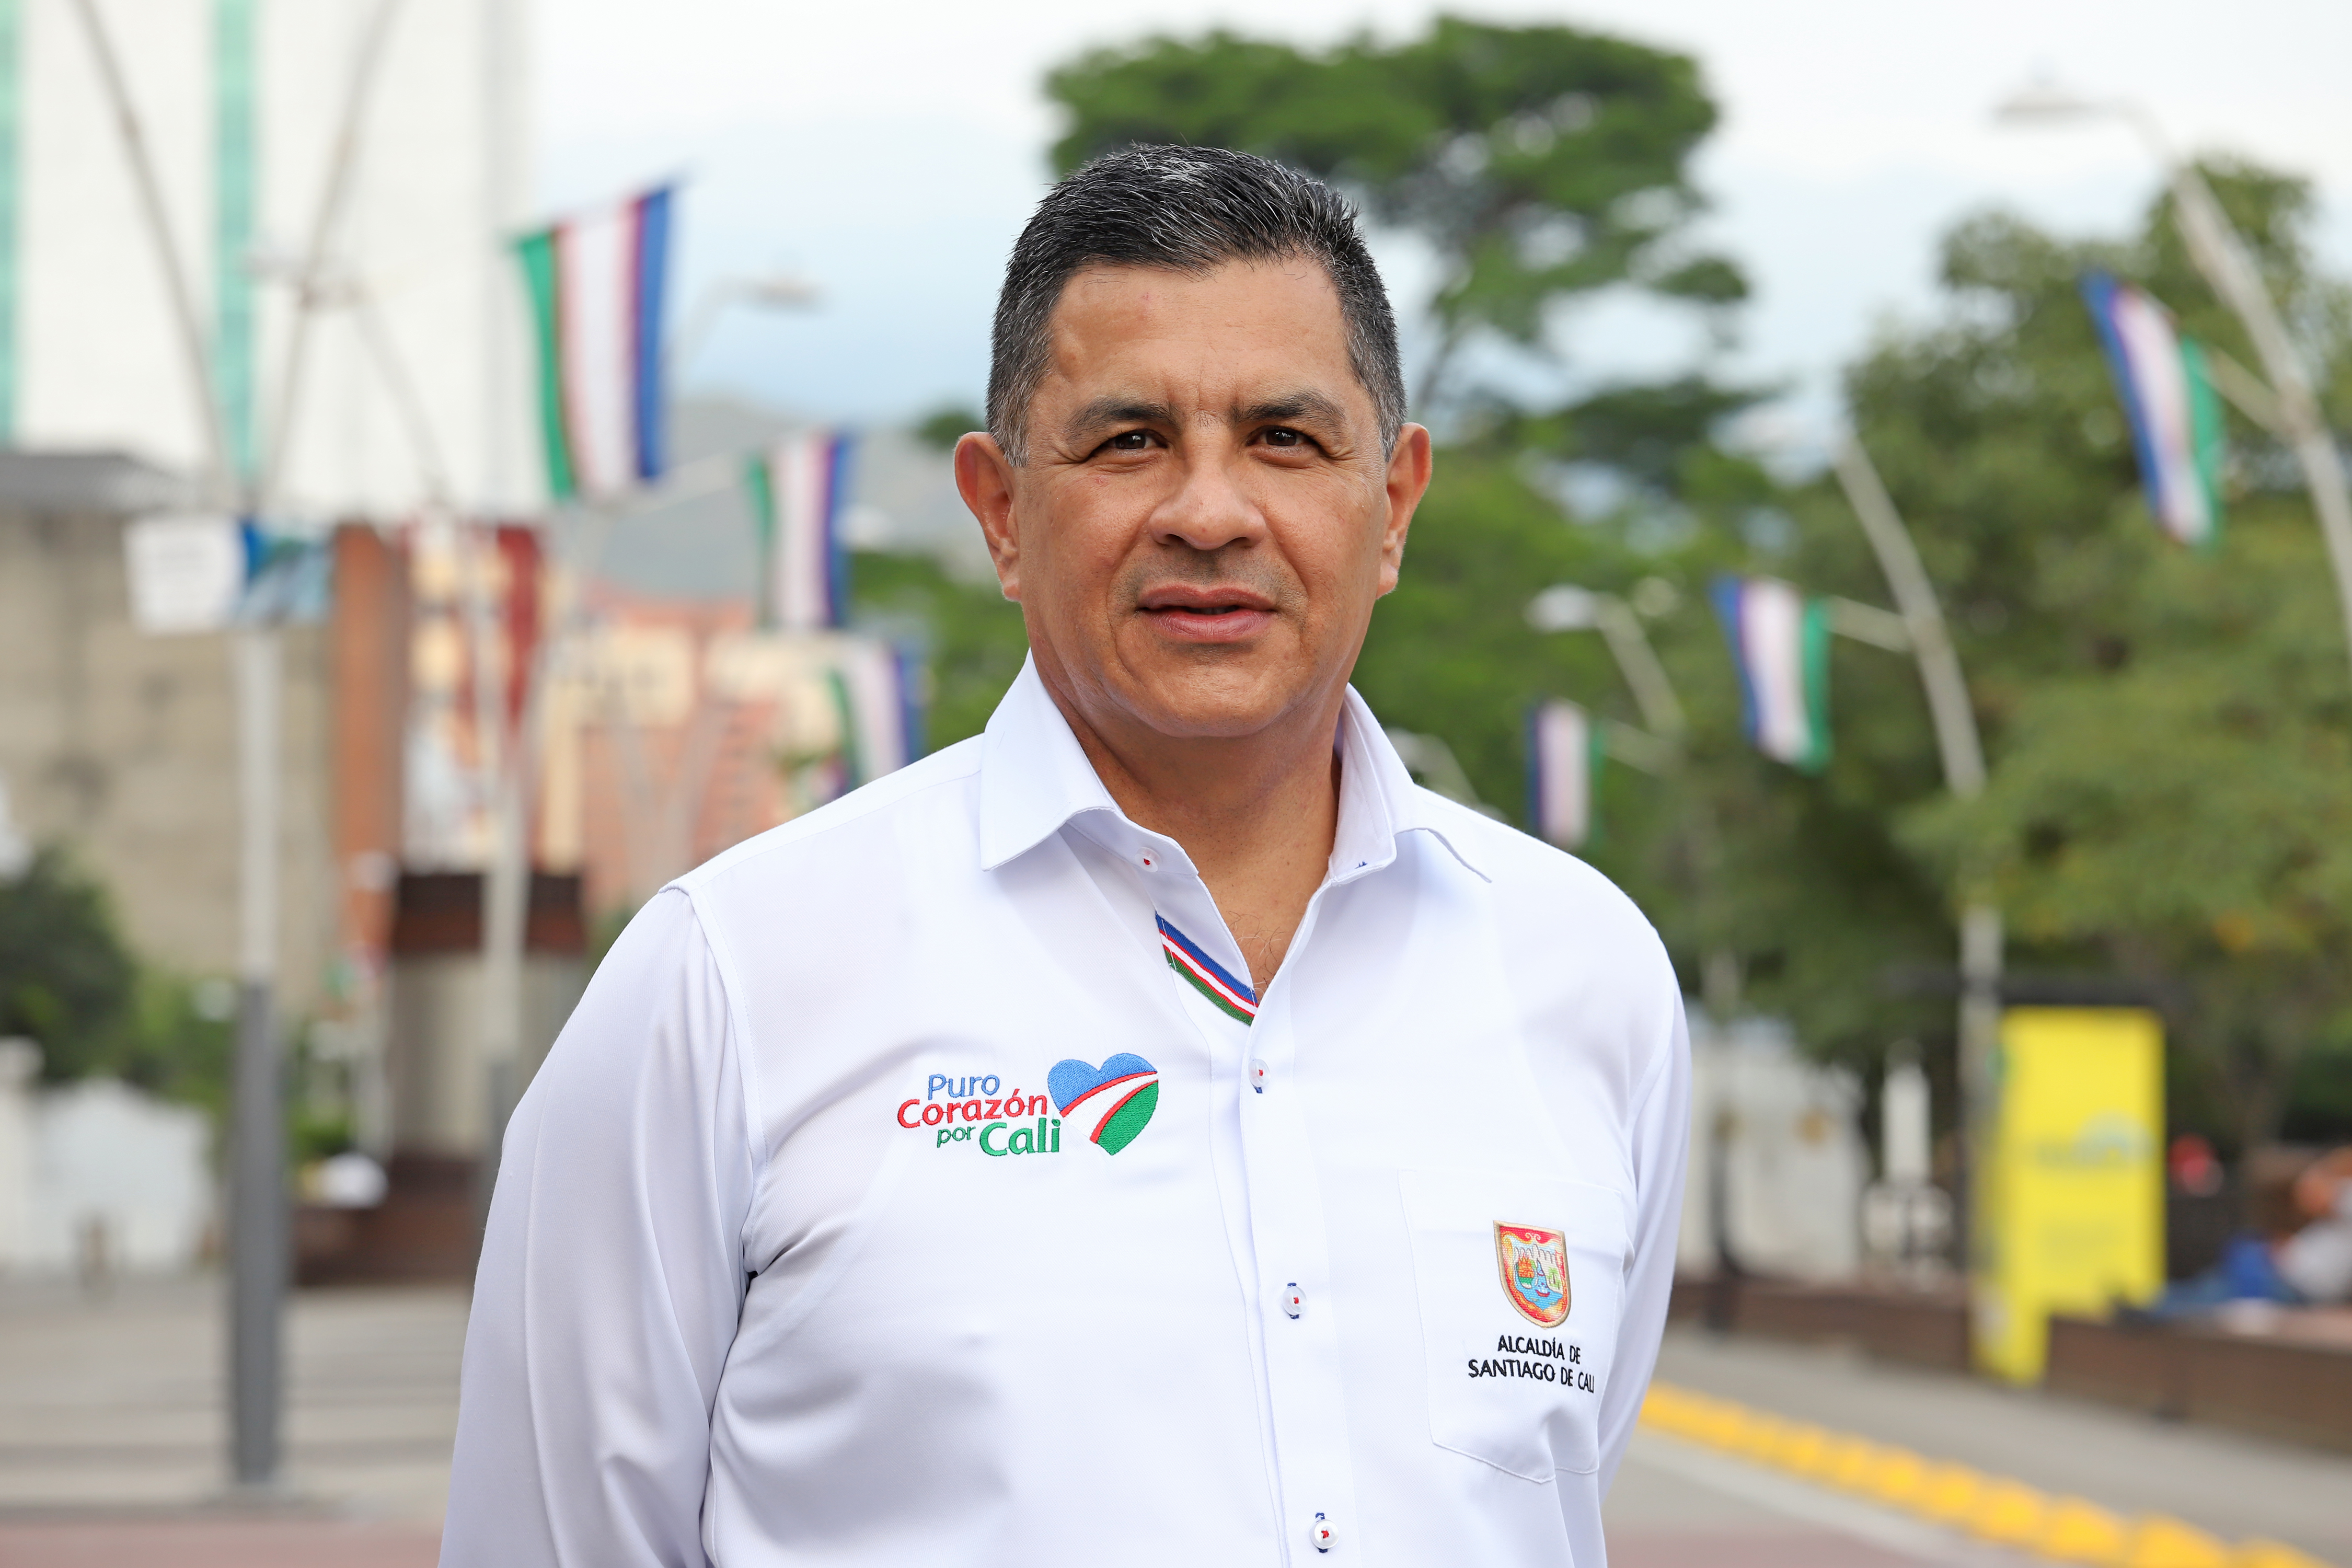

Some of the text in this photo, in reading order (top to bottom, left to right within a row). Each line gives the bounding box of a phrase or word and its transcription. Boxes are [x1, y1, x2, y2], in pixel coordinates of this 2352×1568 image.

[928, 1074, 1000, 1100] Puro
[897, 1089, 1047, 1128] Corazón
[937, 1117, 1061, 1156] por Cali
[1497, 1335, 1581, 1365] ALCALDÍA DE
[1468, 1359, 1595, 1393] SANTIAGO DE CALI
